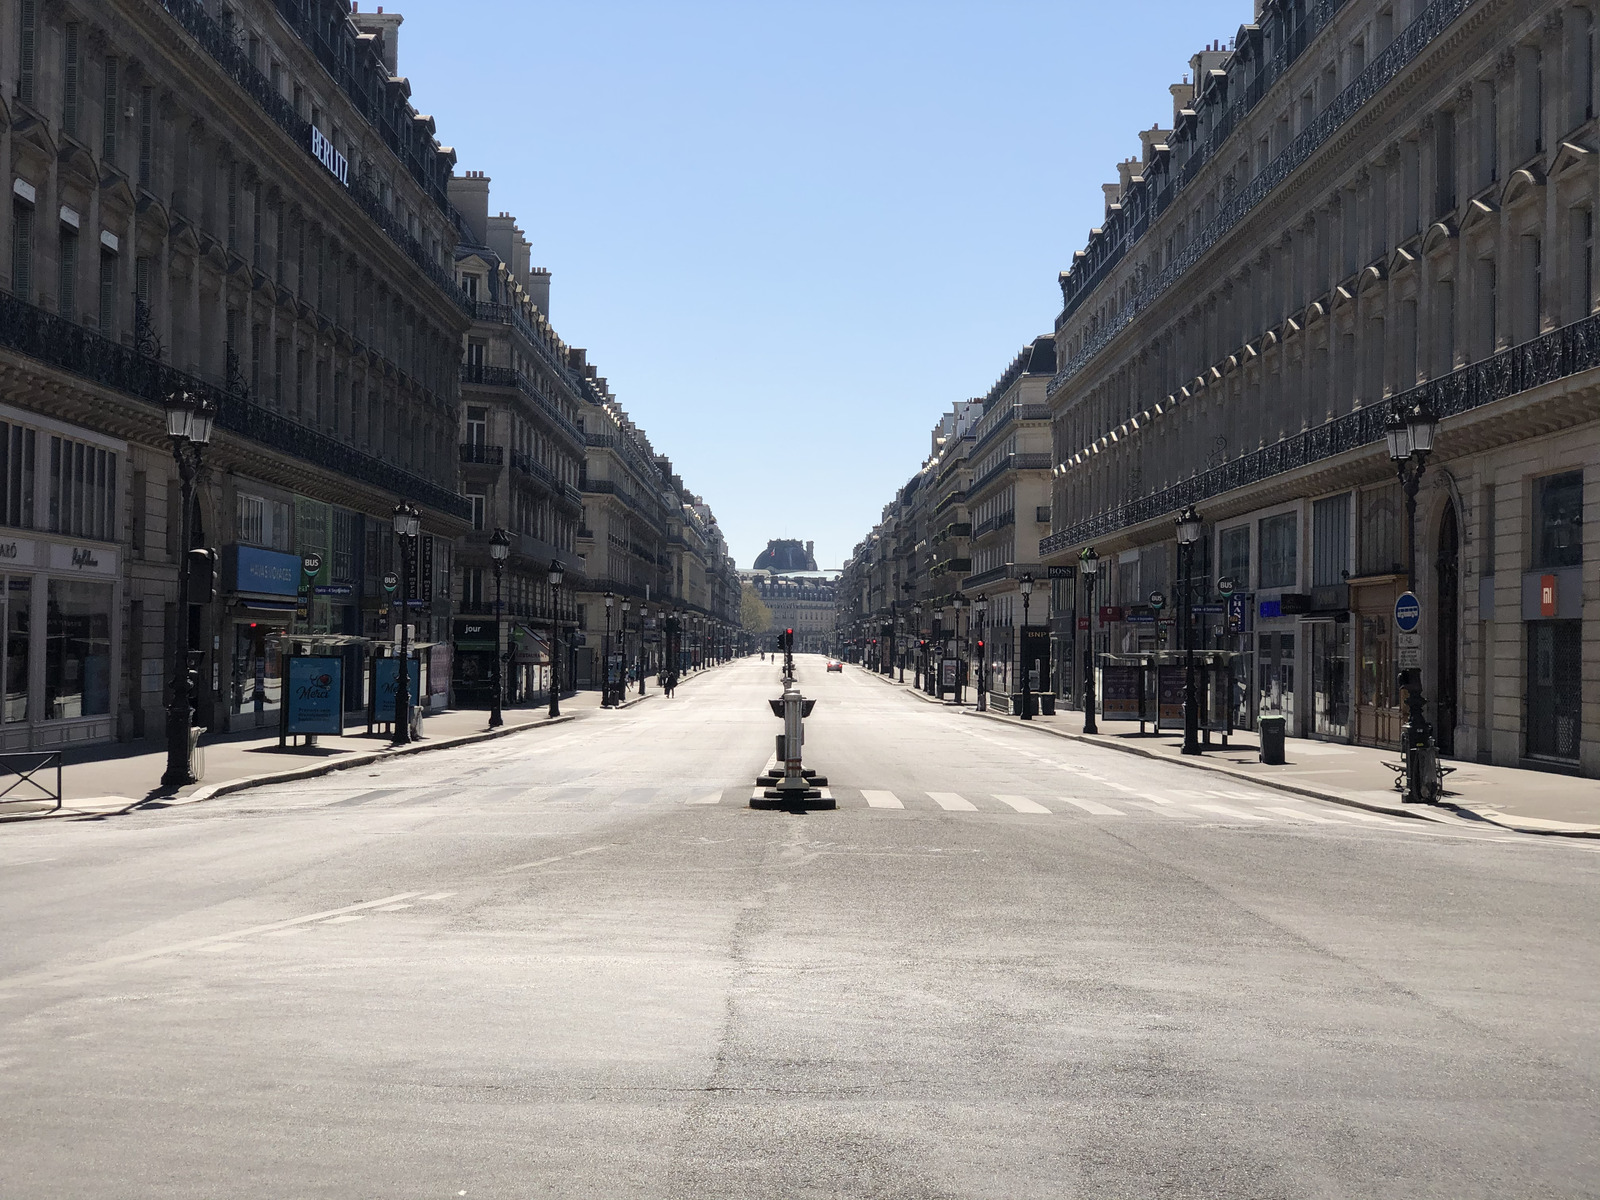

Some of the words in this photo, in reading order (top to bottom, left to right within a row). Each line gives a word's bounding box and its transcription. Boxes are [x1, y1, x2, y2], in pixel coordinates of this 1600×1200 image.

[312, 125, 349, 188] BERLITZ
[304, 559, 319, 567] BUS
[1049, 567, 1072, 575] BOSS
[1219, 581, 1232, 589] BUS
[464, 624, 481, 634] jour
[296, 686, 329, 700] Merci
